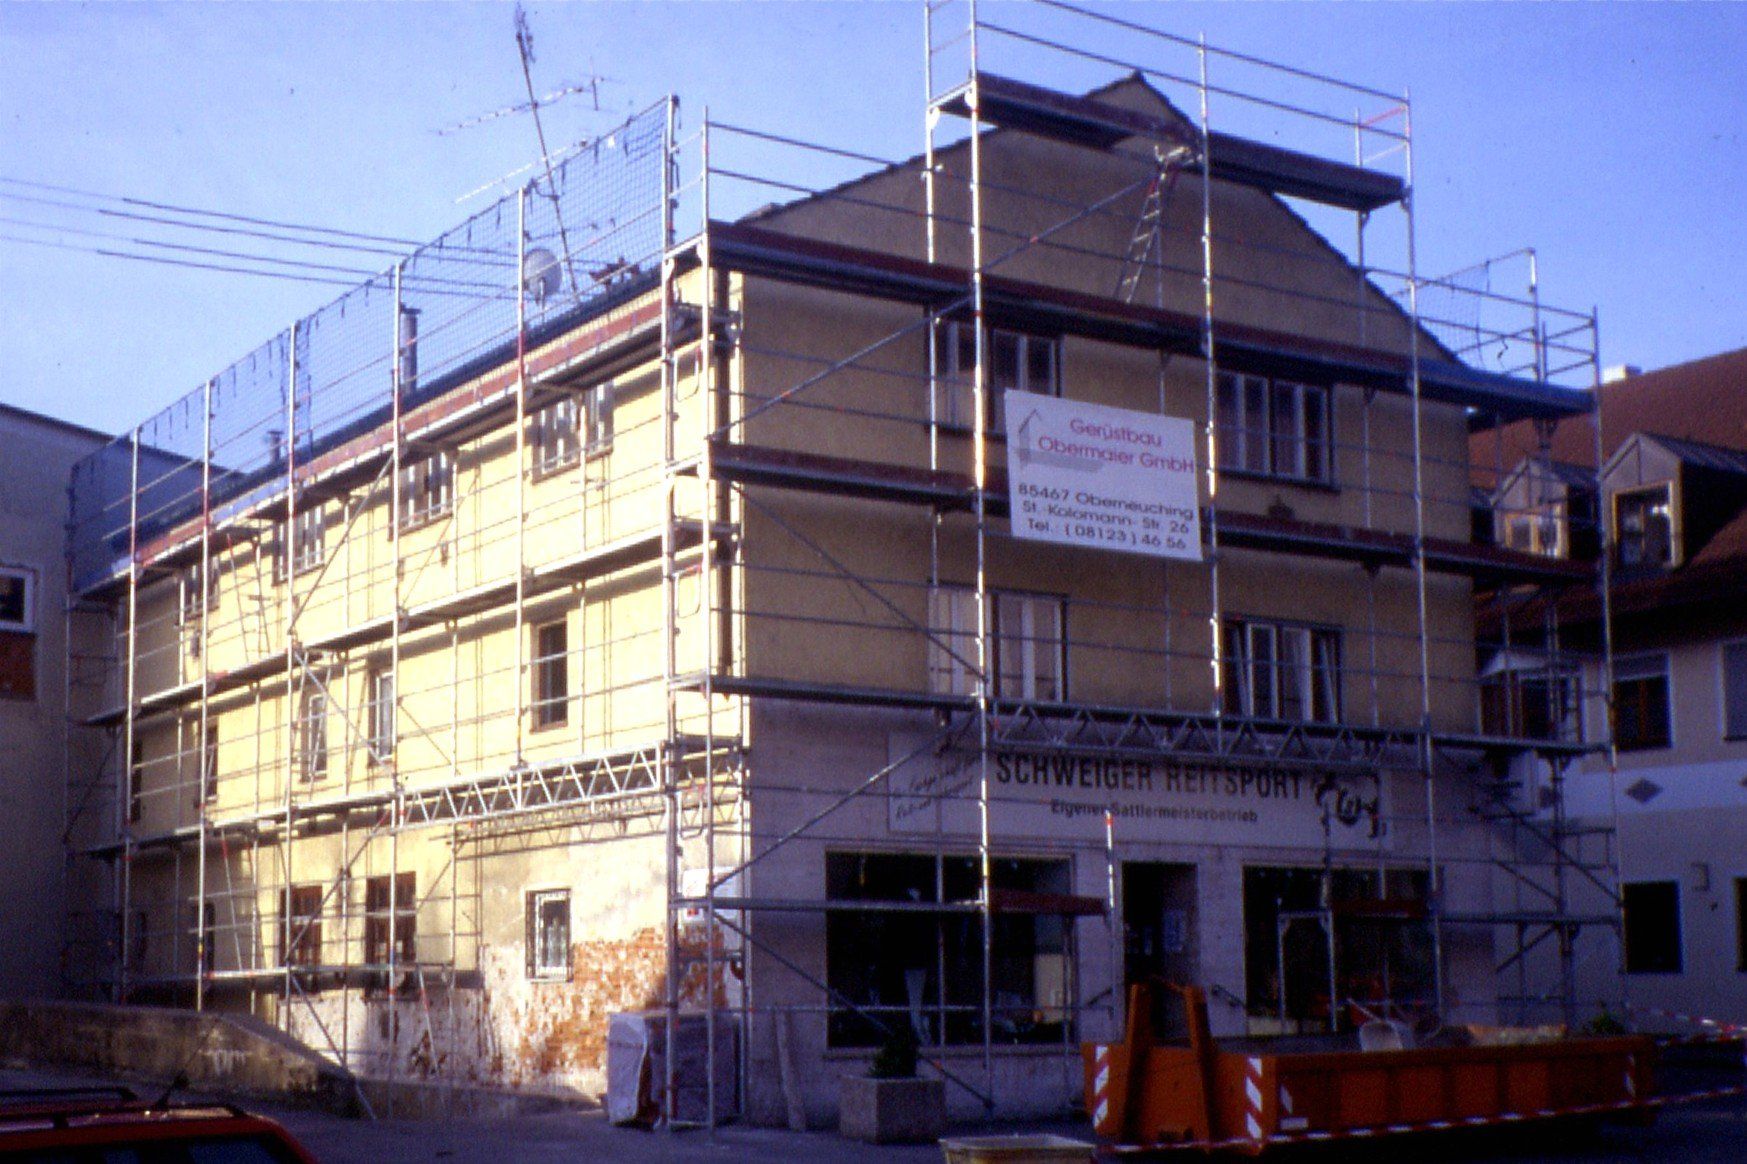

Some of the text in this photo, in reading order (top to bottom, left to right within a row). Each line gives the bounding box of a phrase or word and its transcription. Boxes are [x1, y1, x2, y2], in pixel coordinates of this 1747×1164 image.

[1070, 418, 1162, 447] Gerüstbau
[1038, 436, 1194, 473] Obermaier GmbH
[1018, 483, 1194, 521] 85467 Oberneuching
[1141, 534, 1162, 547] 46
[1166, 536, 1187, 549] 56
[1170, 520, 1190, 534] 26
[996, 752, 1153, 791] SCHWEIGER
[1165, 759, 1301, 799] REITSPORT
[1050, 799, 1107, 817] Eigener
